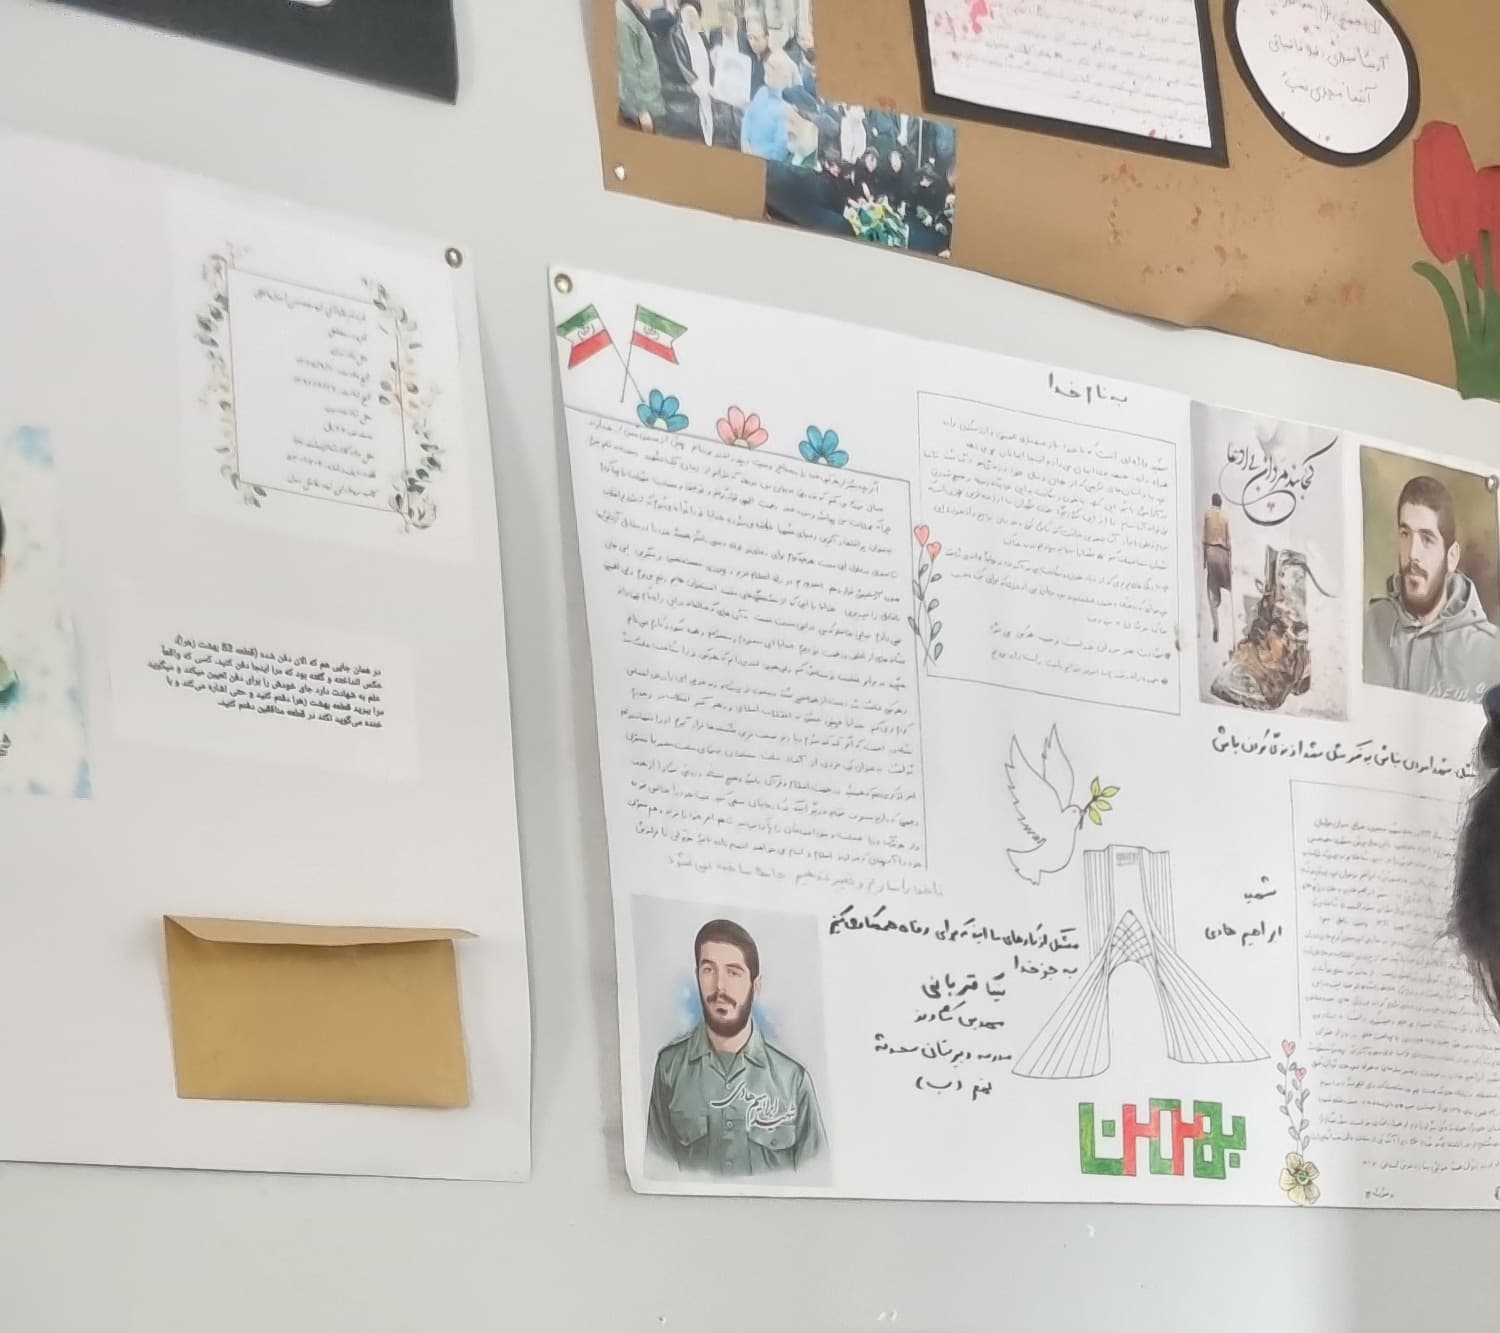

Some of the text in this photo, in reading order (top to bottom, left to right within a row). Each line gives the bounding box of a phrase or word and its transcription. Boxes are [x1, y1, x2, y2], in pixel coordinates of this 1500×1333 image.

[1049, 372, 1081, 398] خدا
[1110, 395, 1128, 406] به
[1284, 435, 1338, 500] کجایند
[1212, 725, 1240, 754] باش
[1244, 875, 1277, 904] شهید
[935, 919, 958, 941] برای
[987, 929, 1001, 941] ما
[1049, 928, 1079, 952] مشکل
[1205, 920, 1282, 947] ابراهیم هادی
[1014, 955, 1039, 974] خدا
[1063, 967, 1078, 979] به
[922, 973, 978, 999] قربانی
[921, 1039, 971, 1068] دبیرستان
